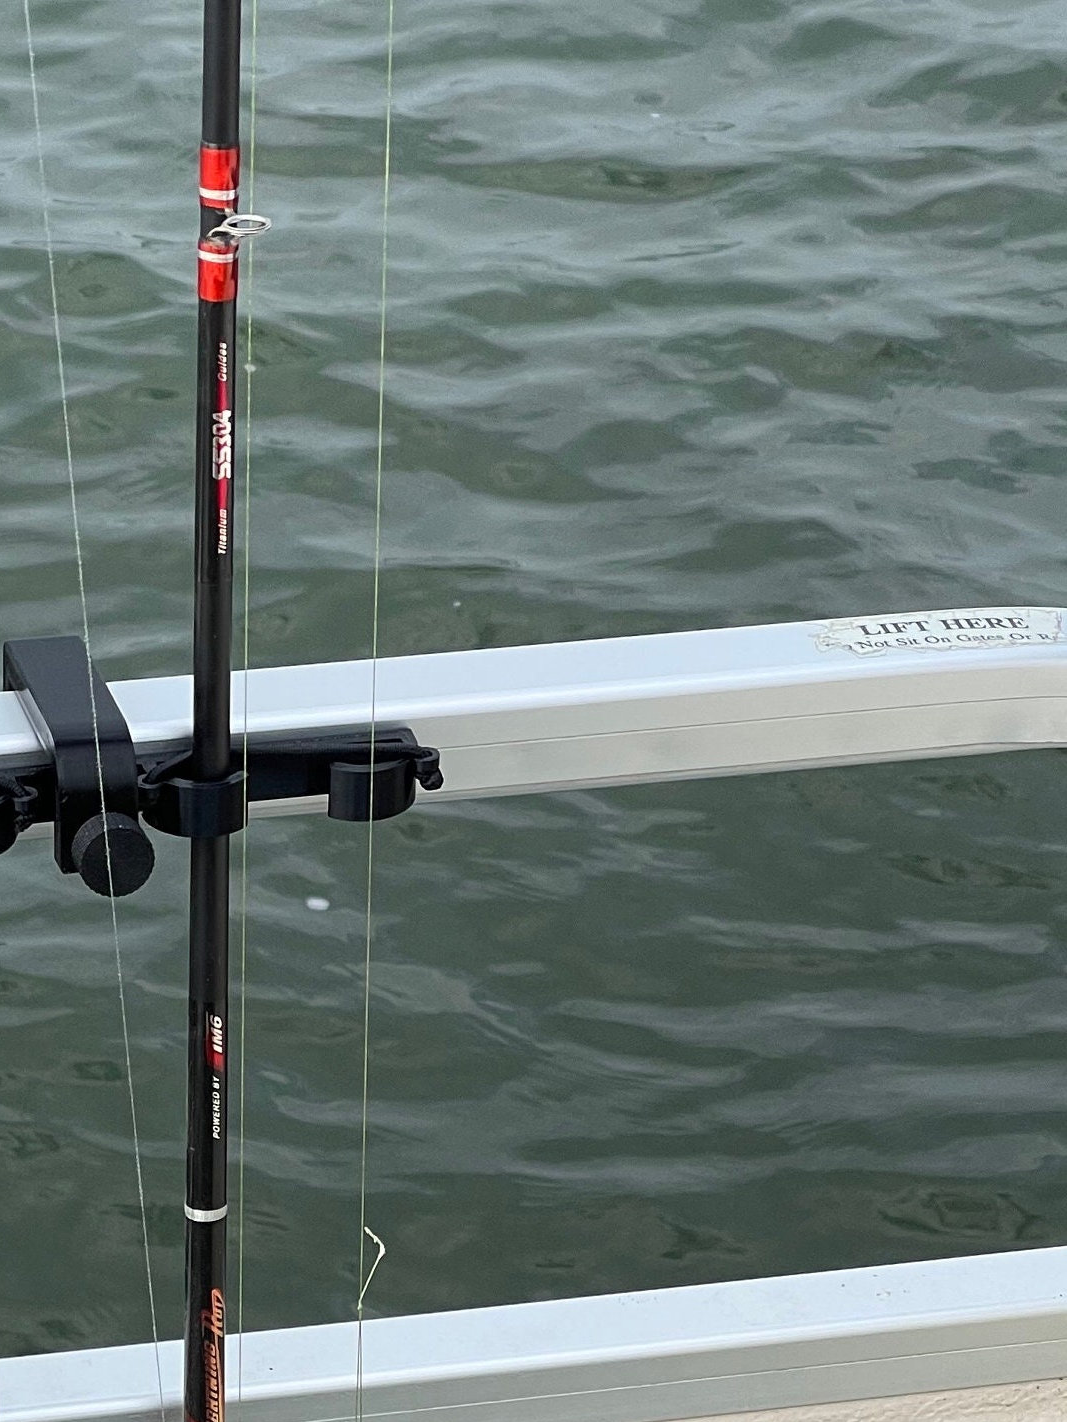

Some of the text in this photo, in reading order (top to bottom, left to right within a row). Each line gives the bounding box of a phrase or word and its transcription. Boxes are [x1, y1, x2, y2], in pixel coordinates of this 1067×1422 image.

[212, 342, 232, 555] Titanium SS304 Guides
[854, 640, 893, 649] Not
[898, 637, 919, 647] Sit
[925, 635, 951, 644] On
[958, 632, 1005, 643] Gates
[1009, 632, 1032, 640] Or
[858, 616, 1030, 636] LIFT HERE
[209, 1013, 224, 1139] POWERED BY IM6
